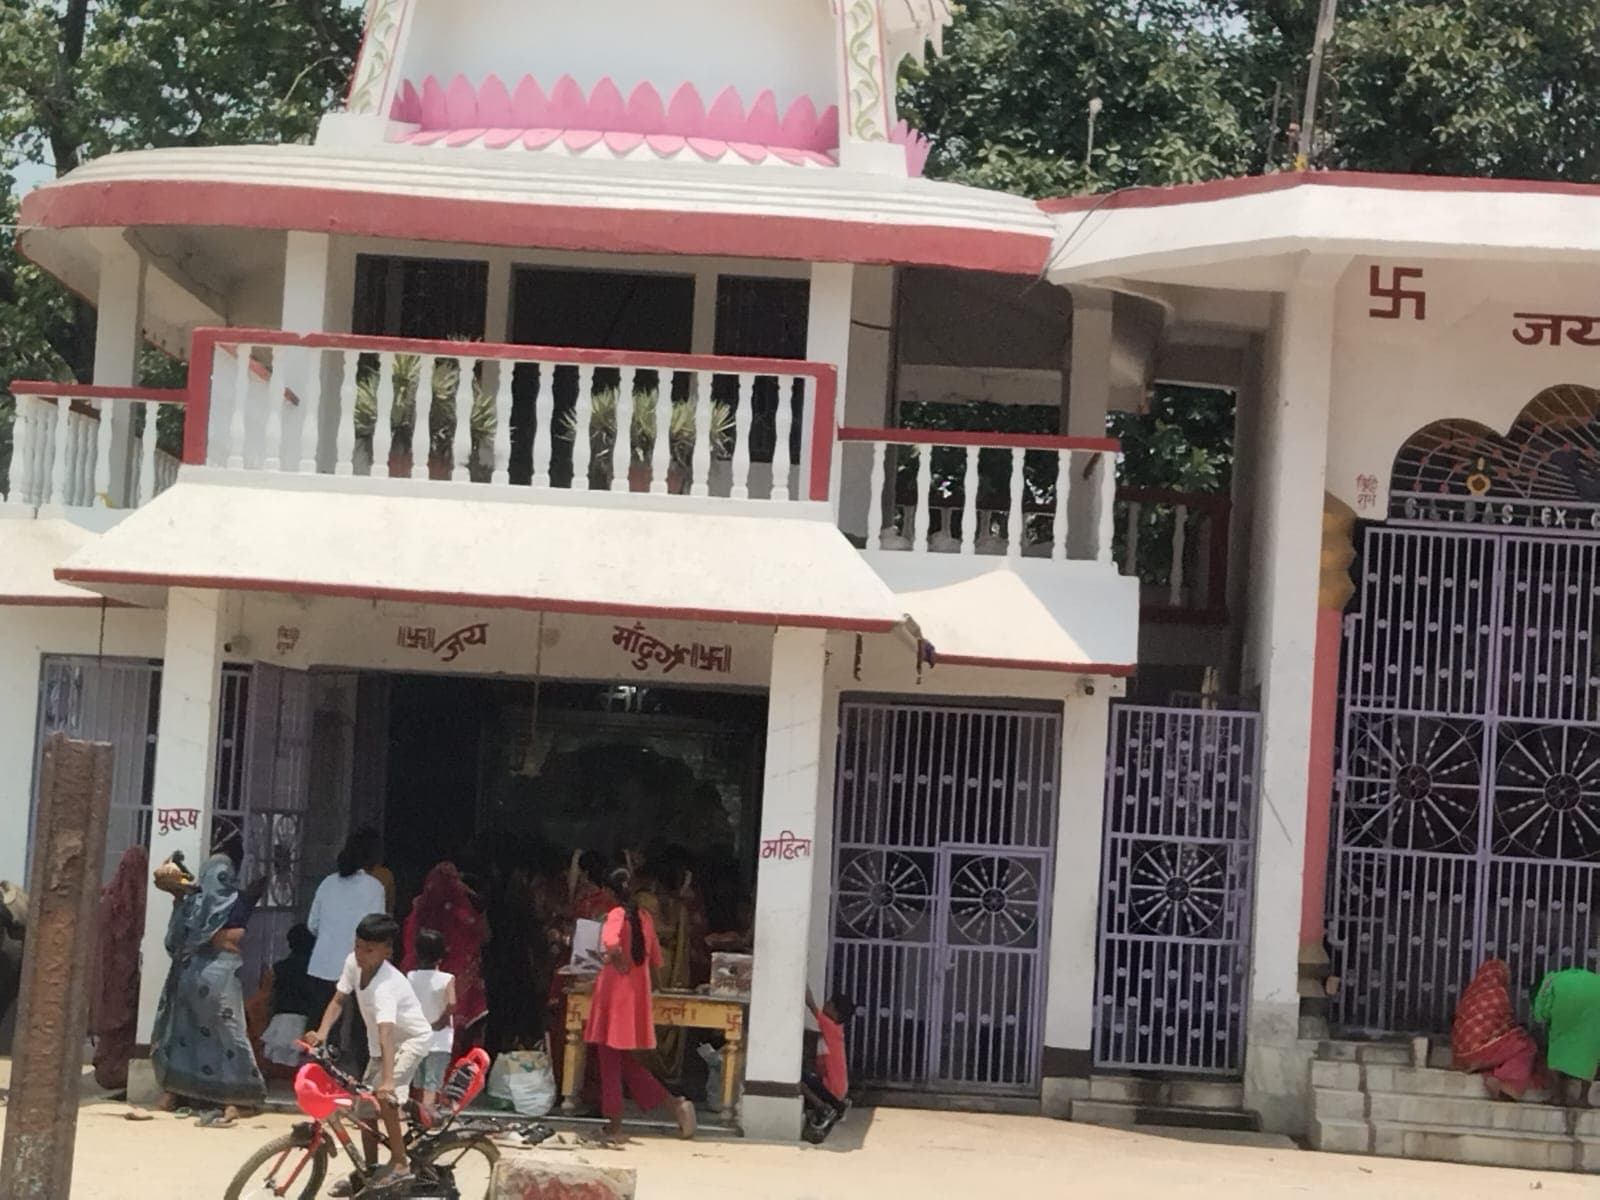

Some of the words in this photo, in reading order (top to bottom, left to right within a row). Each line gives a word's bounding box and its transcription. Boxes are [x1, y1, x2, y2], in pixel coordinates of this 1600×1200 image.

[1512, 312, 1600, 346] जय
[433, 622, 489, 662] जय
[762, 829, 812, 860] महिला
